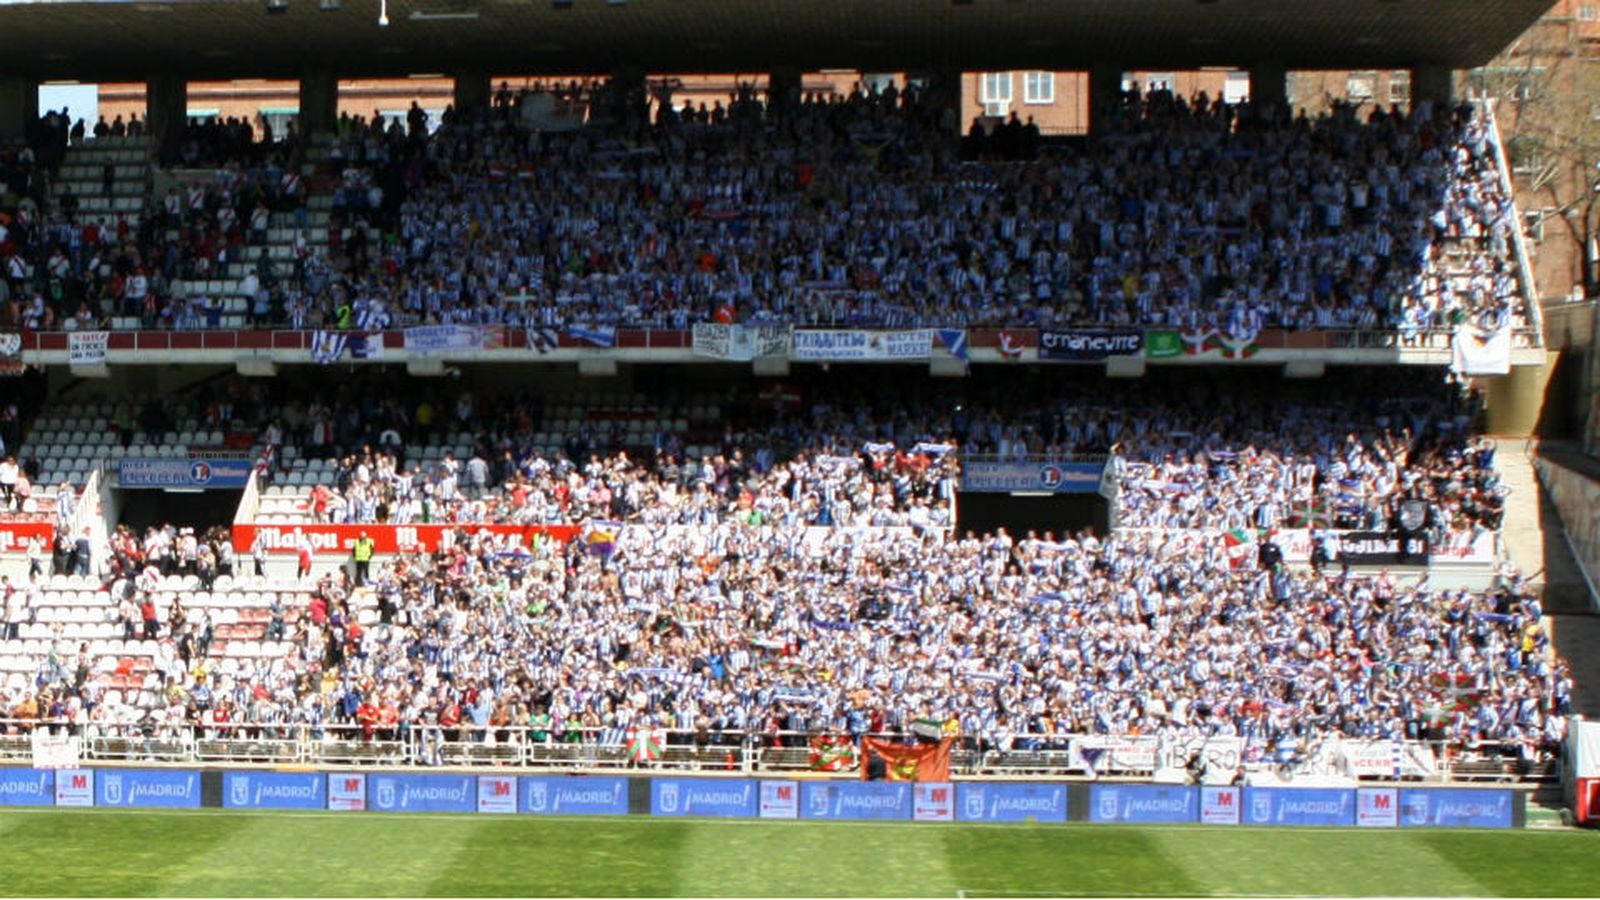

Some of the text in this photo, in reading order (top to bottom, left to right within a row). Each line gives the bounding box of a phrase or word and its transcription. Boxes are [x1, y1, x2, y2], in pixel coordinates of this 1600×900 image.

[0, 773, 46, 796] ADRID!
[72, 775, 87, 788] M
[128, 776, 194, 804] ¡MADRID!
[254, 777, 319, 805] ¡MADRID!
[345, 779, 360, 792] M
[402, 779, 468, 807] ¡MADRID!
[494, 782, 510, 795] M
[777, 786, 791, 800] M
[553, 781, 621, 810] ¡MADRID!
[685, 784, 751, 812] ¡MADRID!
[835, 787, 904, 815] ¡MADRID!
[931, 789, 948, 802] M
[990, 789, 1059, 816] ¡MADRID!
[1124, 792, 1190, 819] ¡MADRID!
[1218, 792, 1233, 806] M
[1277, 794, 1348, 821] ¡MADRID!
[1374, 795, 1390, 808] M
[1435, 796, 1507, 824] ¡MADRID!
